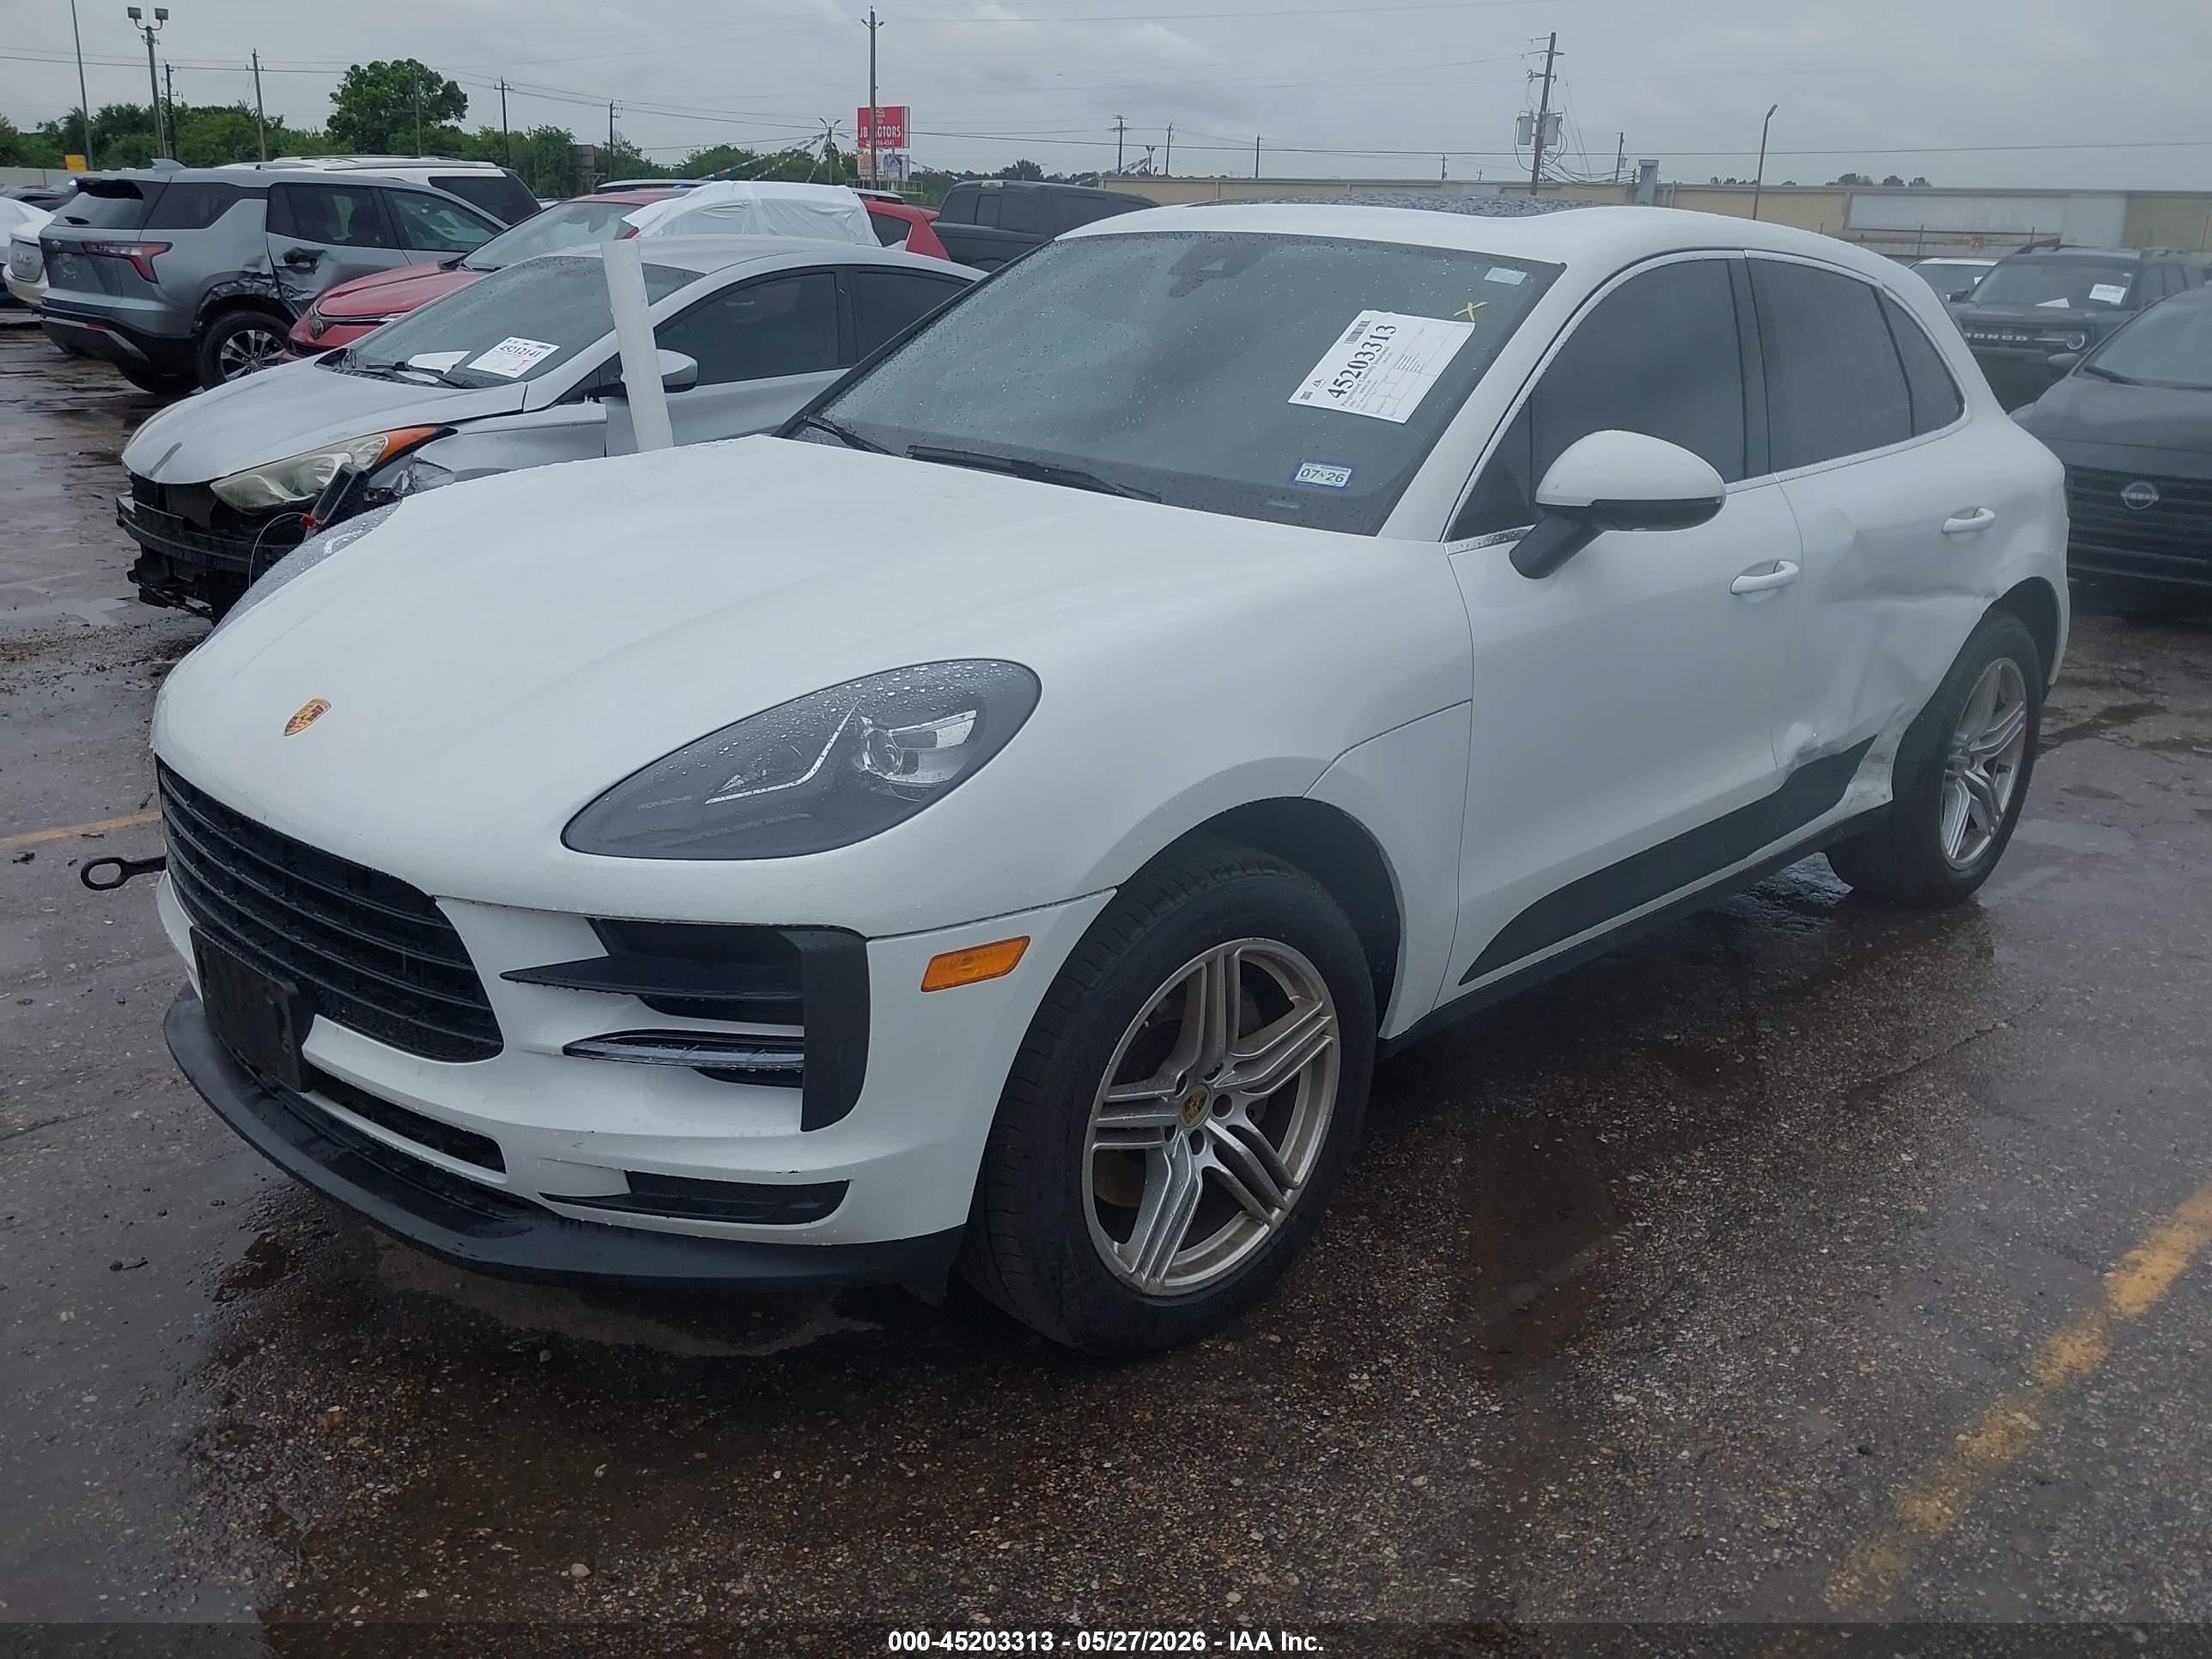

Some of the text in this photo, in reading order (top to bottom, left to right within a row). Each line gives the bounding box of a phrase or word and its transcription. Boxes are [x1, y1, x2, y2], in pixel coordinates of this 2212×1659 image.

[860, 125, 901, 138] JB OTORS
[1327, 325, 1397, 398] 45203313
[1301, 469, 1346, 483] 07 26
